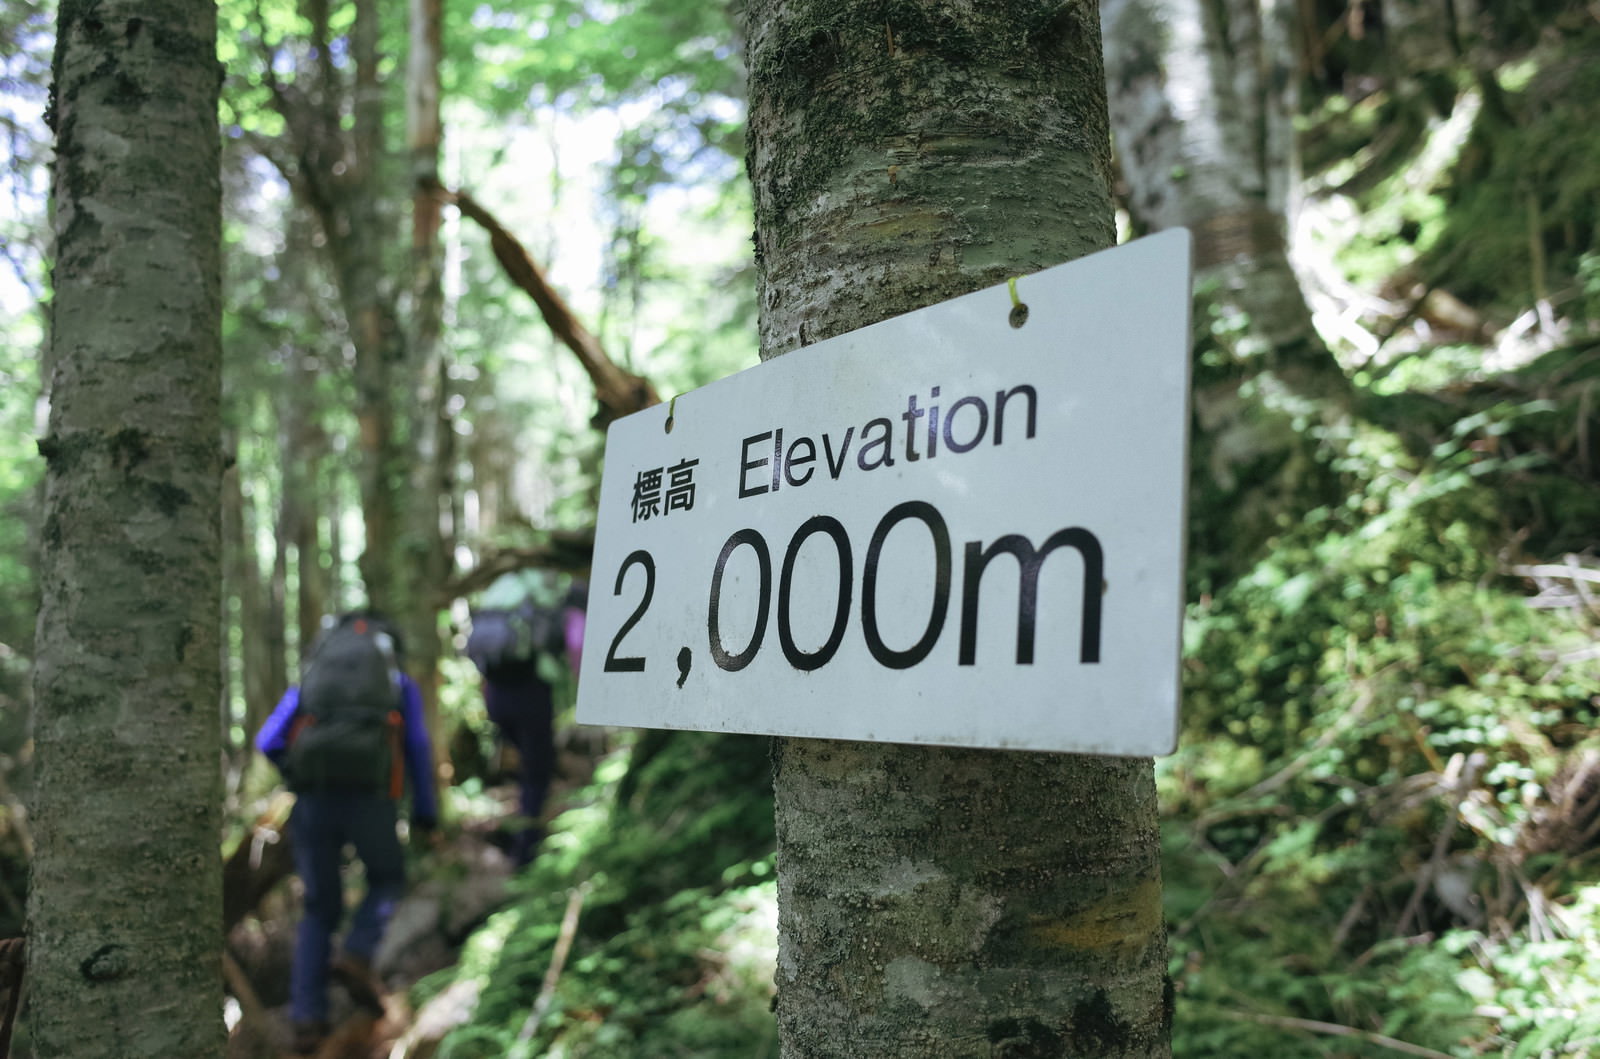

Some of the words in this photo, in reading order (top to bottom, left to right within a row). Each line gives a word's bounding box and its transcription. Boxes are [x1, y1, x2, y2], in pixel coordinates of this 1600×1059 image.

[630, 457, 700, 524] 標高
[738, 384, 1038, 500] Elevation
[603, 500, 1105, 690] 2,000m
